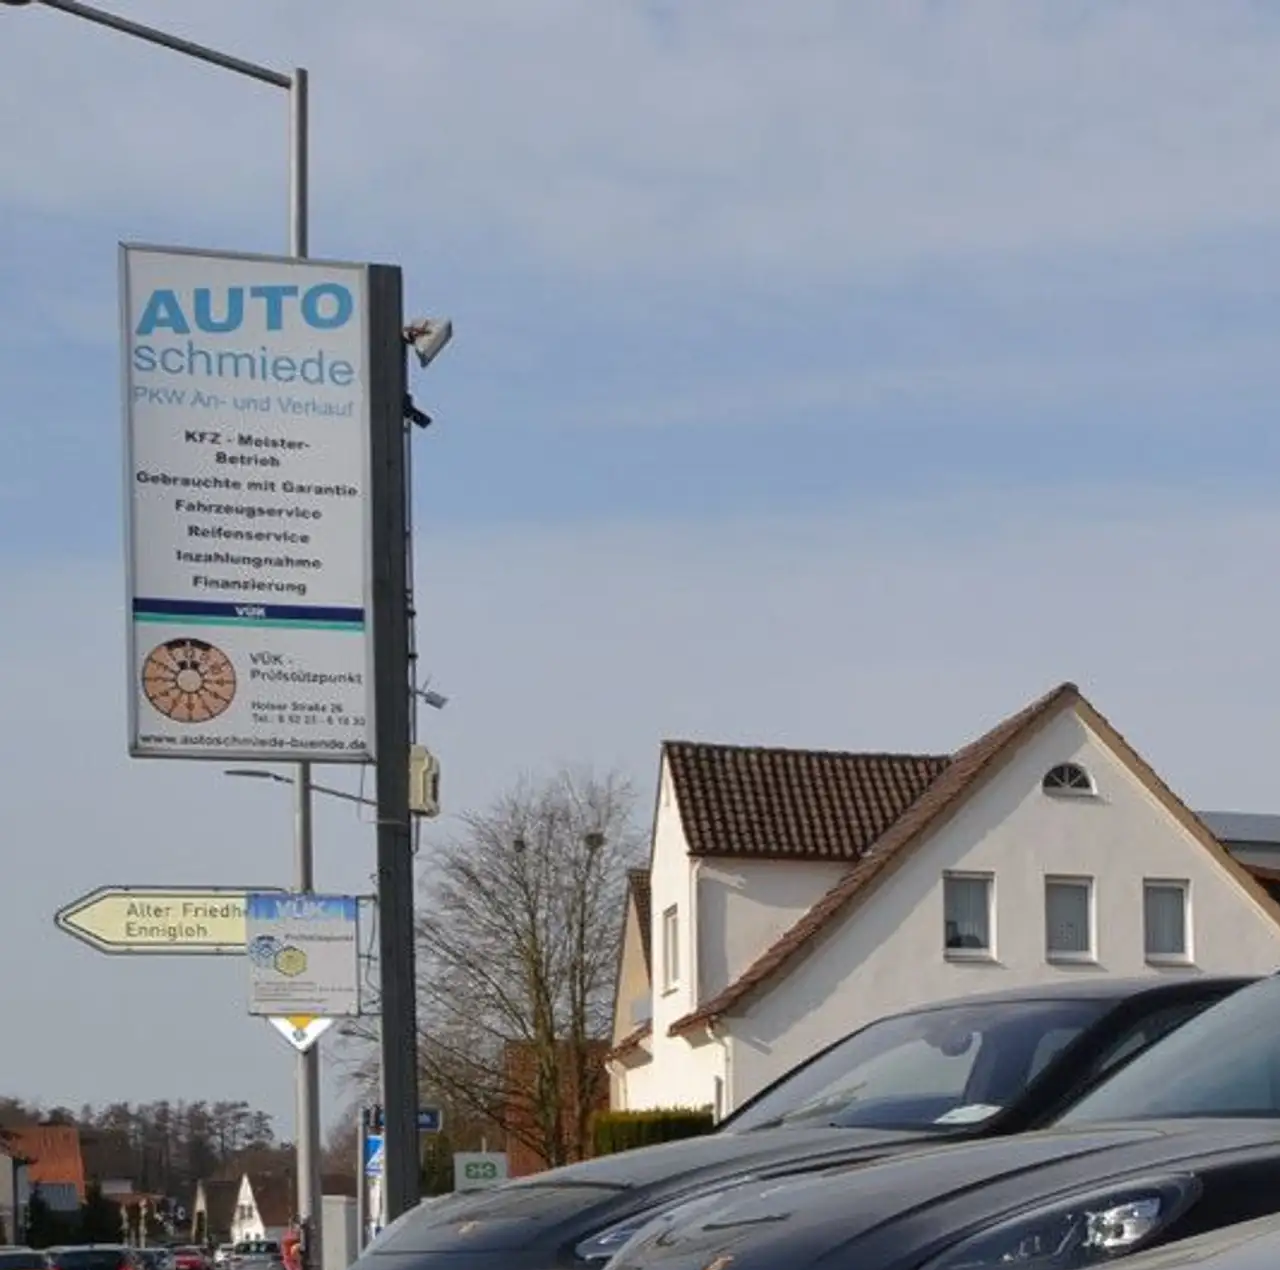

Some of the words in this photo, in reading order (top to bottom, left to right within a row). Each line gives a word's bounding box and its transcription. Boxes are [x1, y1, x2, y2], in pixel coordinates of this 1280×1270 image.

[136, 283, 354, 337] AUTO
[133, 341, 355, 386] schmiede
[133, 386, 185, 406] PKW
[189, 389, 227, 409] An-
[233, 395, 271, 413] und
[277, 397, 354, 418] Verkauf
[184, 431, 222, 446] KFZ
[237, 433, 311, 450] Meister-
[215, 451, 281, 468] Betrieb
[136, 470, 242, 491] Gebrauchte
[246, 479, 276, 493] mit
[282, 480, 359, 498] Garantie
[175, 499, 322, 521] Fahrzeugservice
[187, 525, 311, 545] Reifenservice
[175, 550, 323, 570] Inzahlungnahme
[192, 575, 308, 596] Finanzierung
[126, 902, 172, 918] Alter
[182, 901, 247, 918] Friedh
[125, 921, 208, 941] Ennigloh
